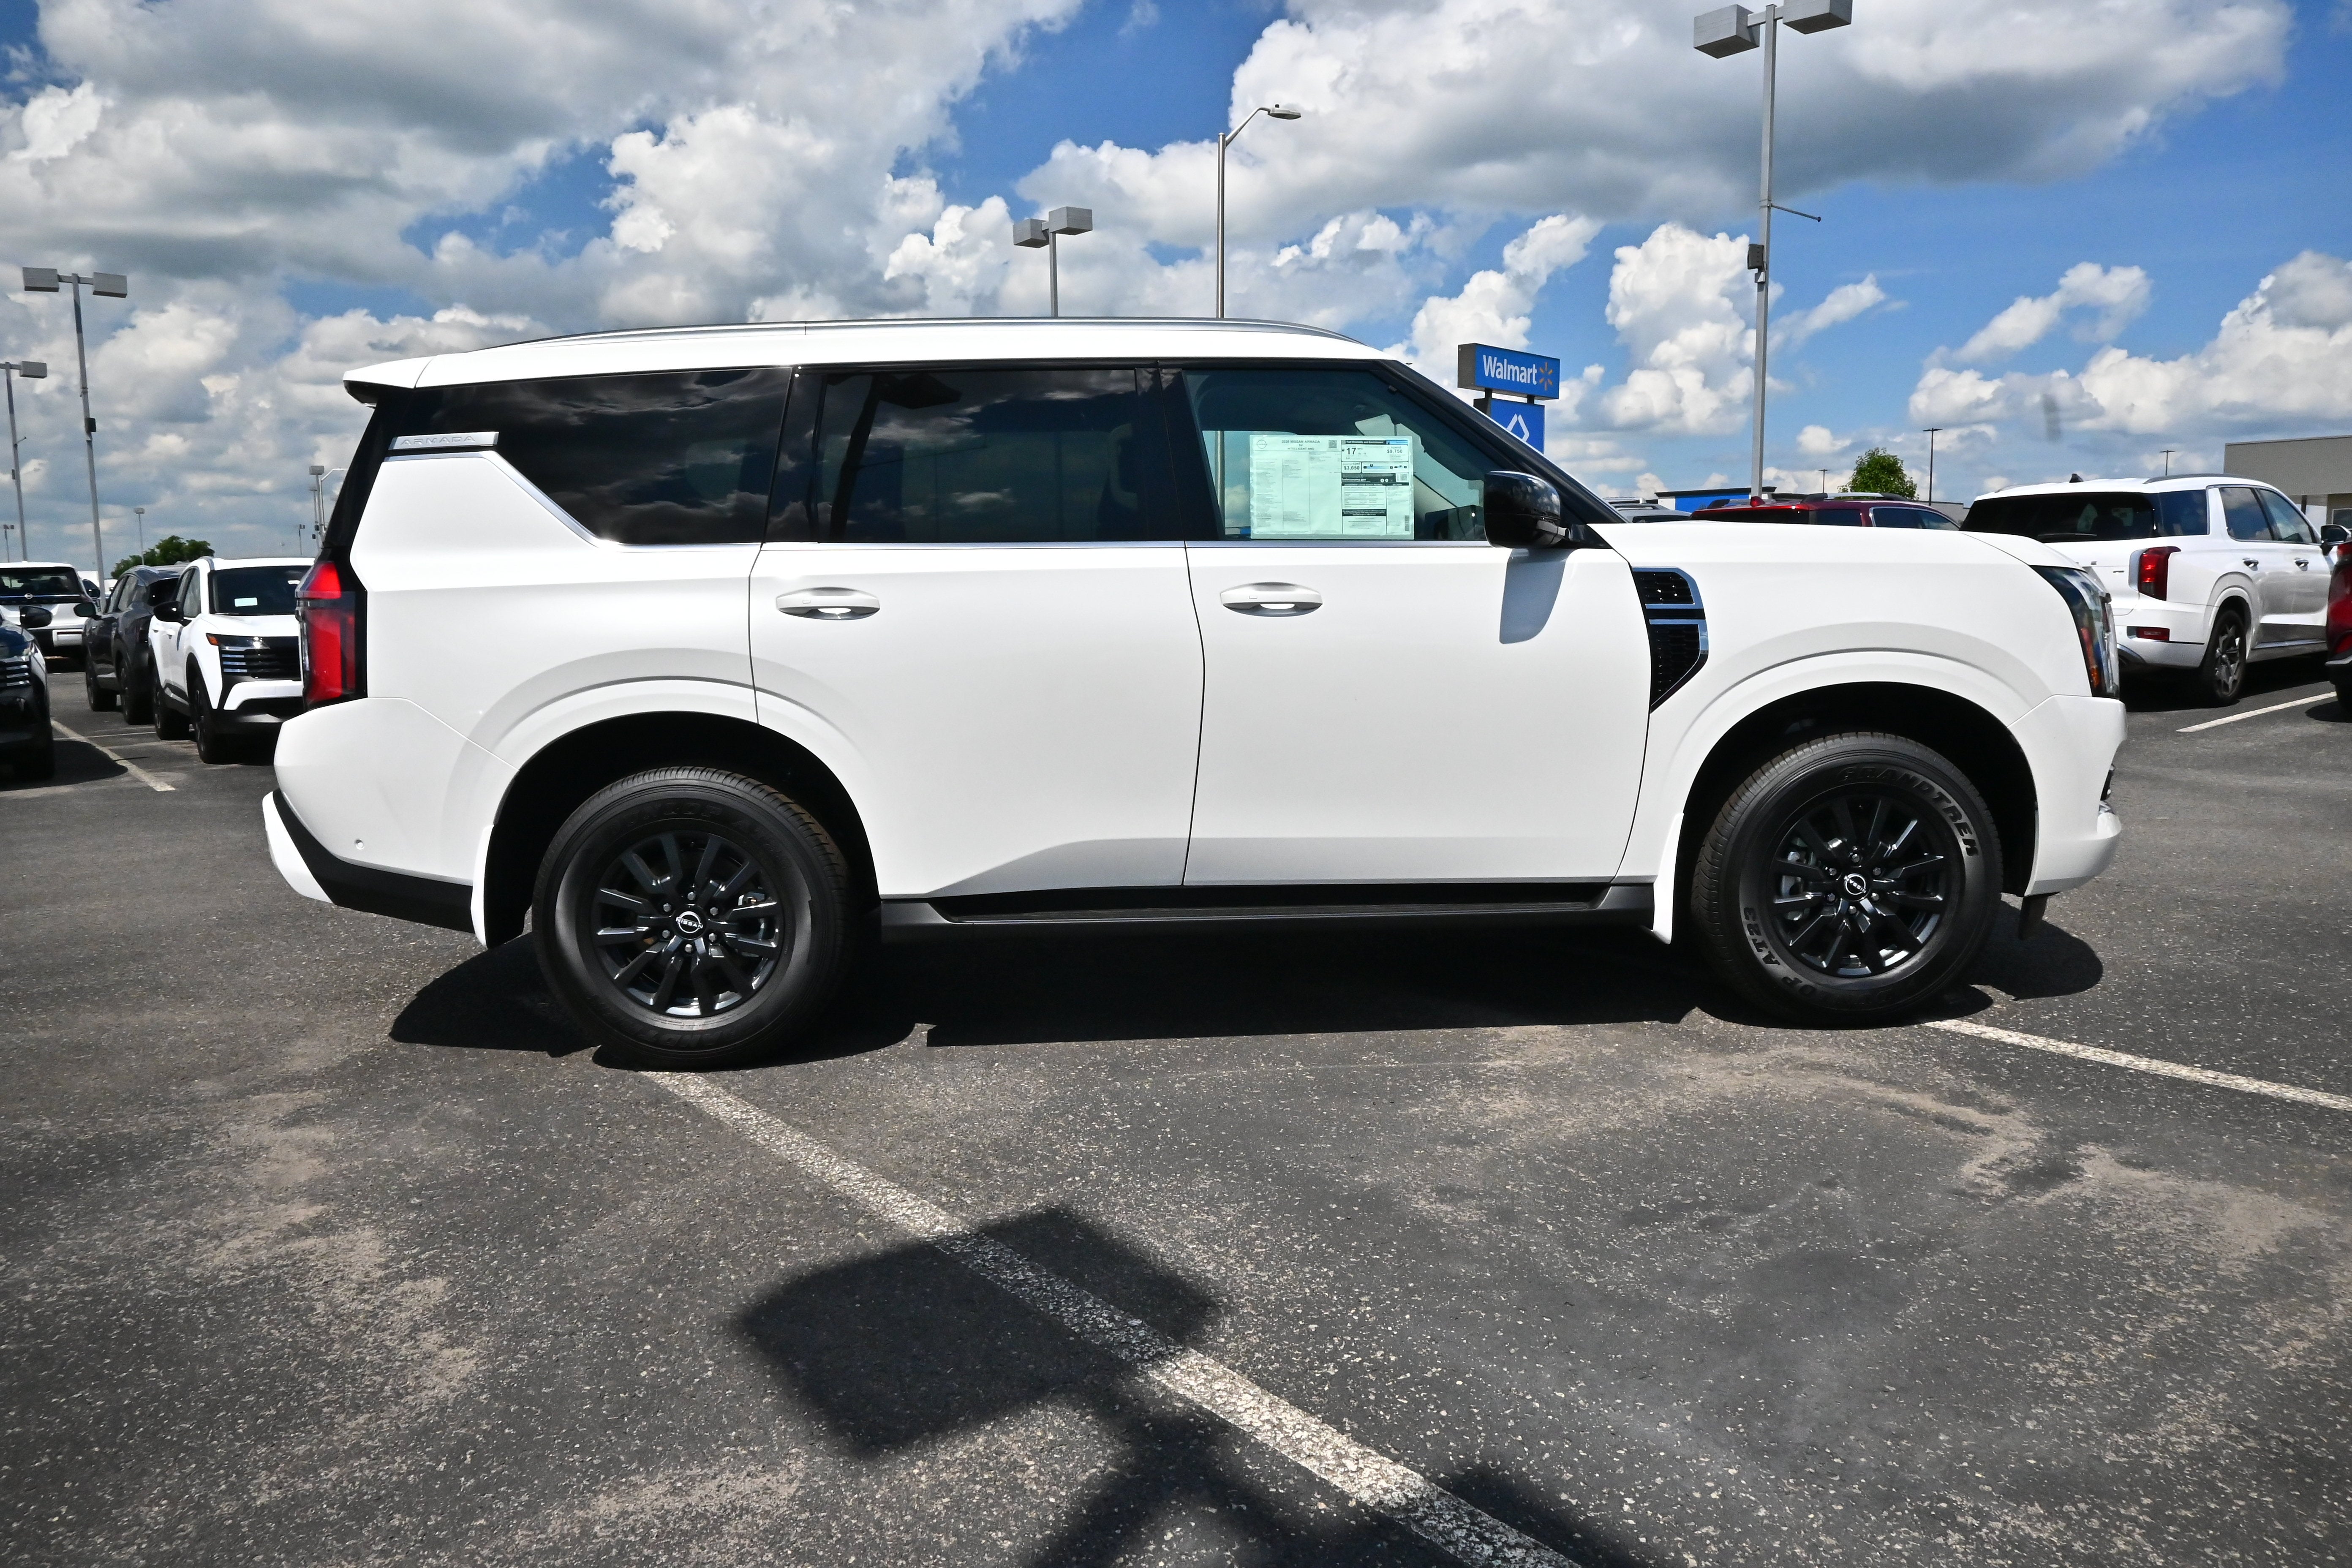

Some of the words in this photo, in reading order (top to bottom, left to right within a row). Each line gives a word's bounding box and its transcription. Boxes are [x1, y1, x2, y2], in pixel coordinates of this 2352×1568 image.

[1483, 354, 1537, 385] Walmart
[401, 436, 476, 446] ARMADA
[1838, 766, 1979, 857] GRANDTREK
[1844, 875, 1867, 893] NISSAN
[676, 917, 703, 929] NISSAN
[1743, 907, 1780, 965] AT23
